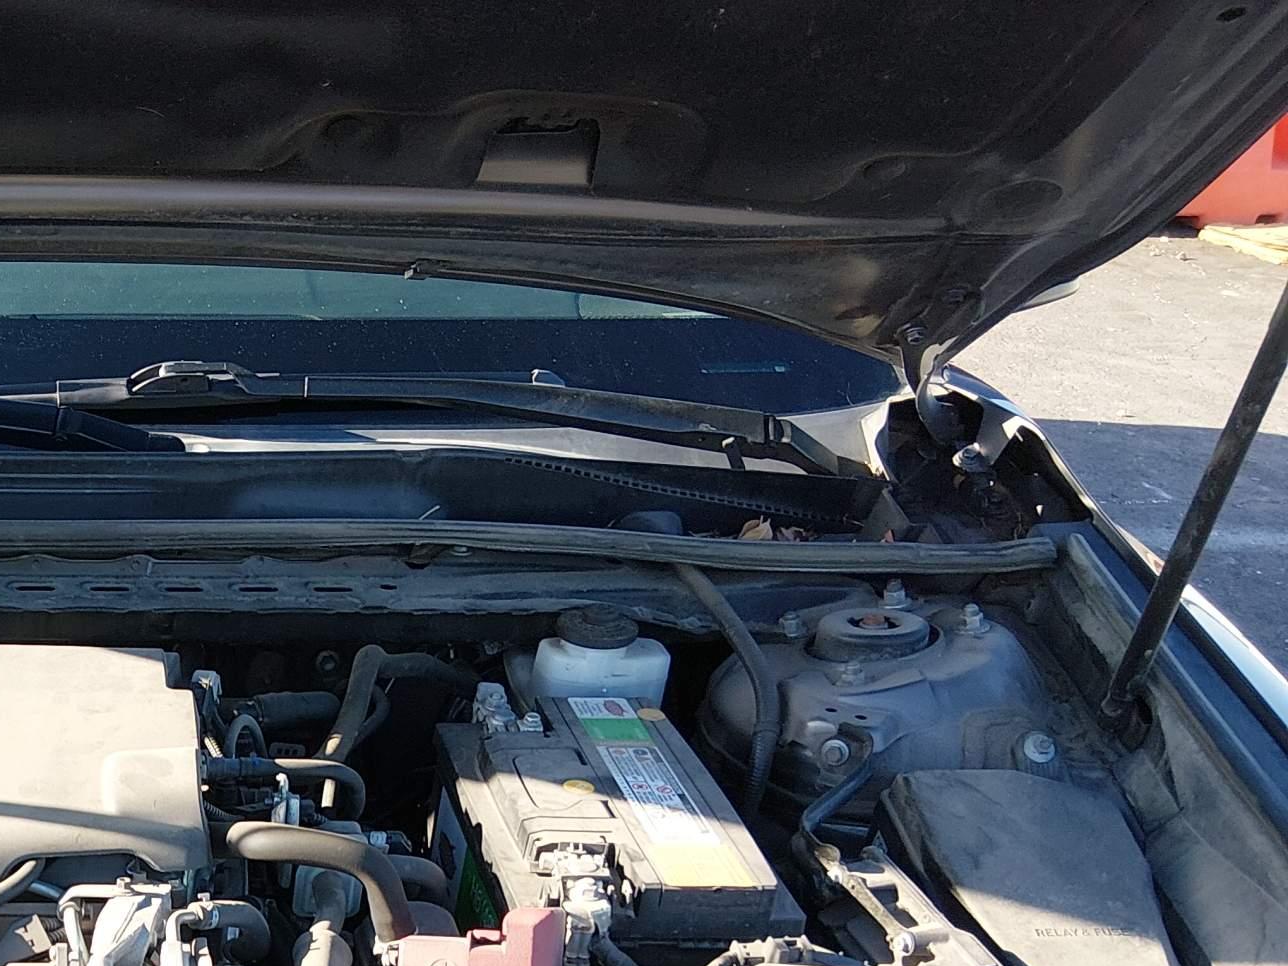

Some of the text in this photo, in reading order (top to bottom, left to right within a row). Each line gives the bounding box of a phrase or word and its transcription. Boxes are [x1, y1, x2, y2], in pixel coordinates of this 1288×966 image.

[1034, 927, 1132, 938] RELAY & FUSE
